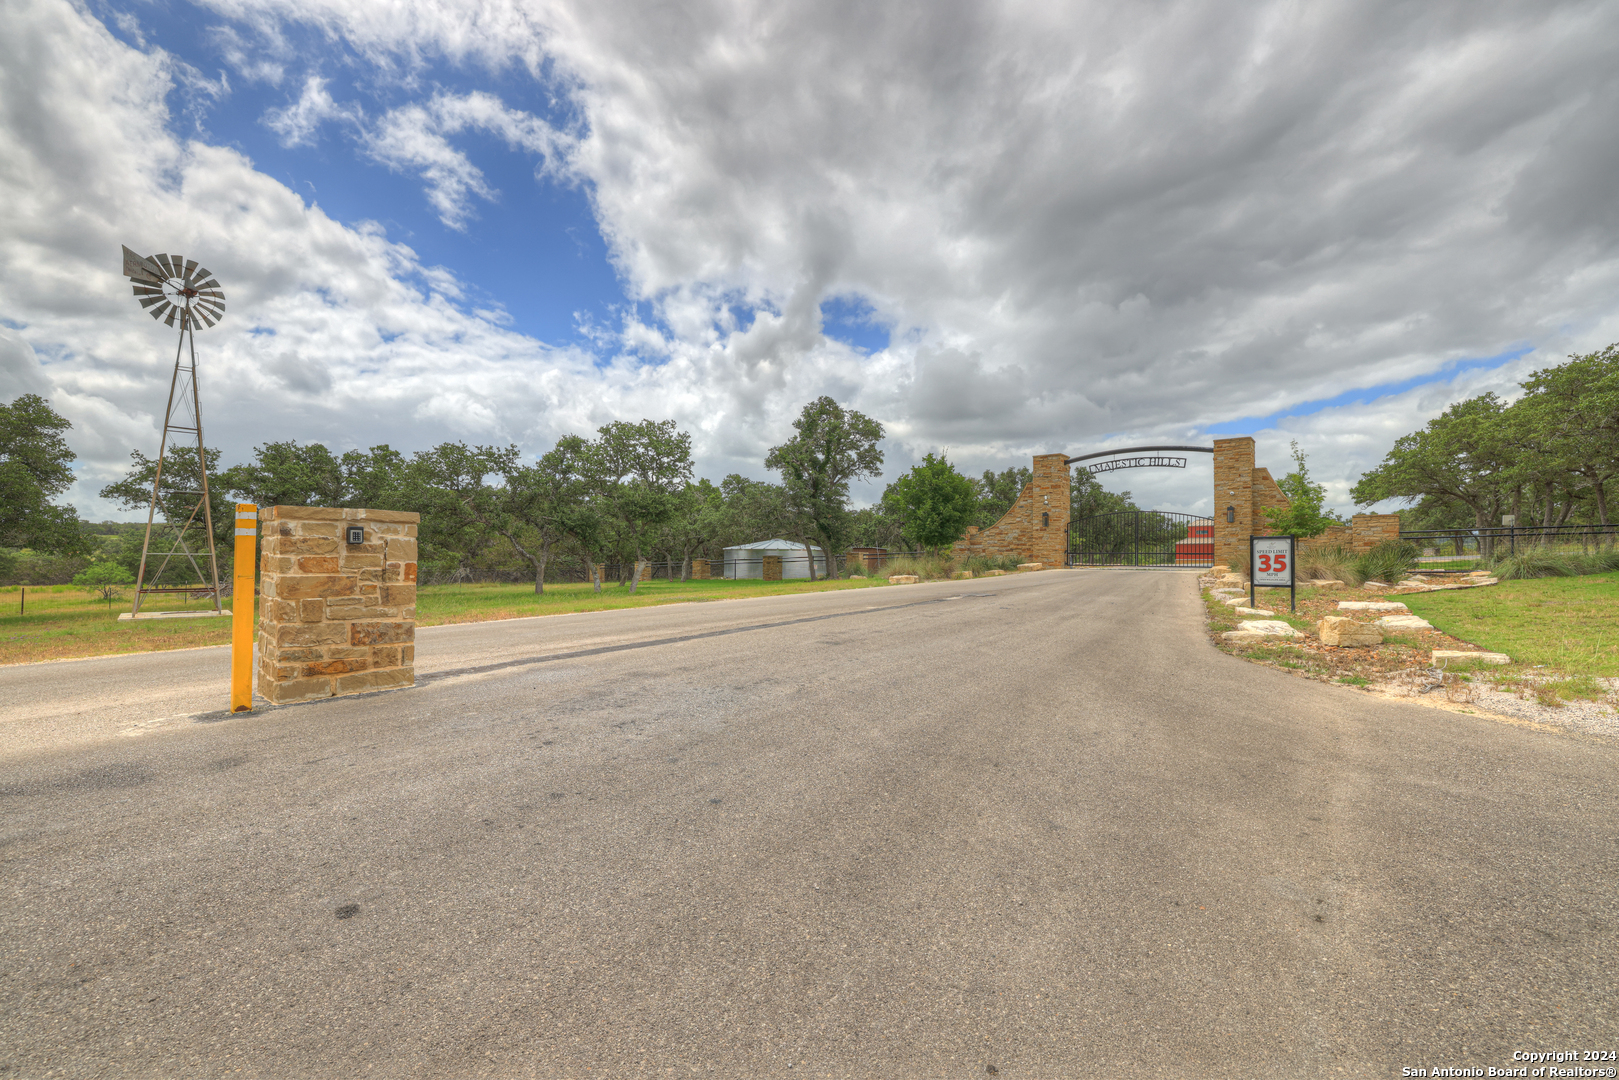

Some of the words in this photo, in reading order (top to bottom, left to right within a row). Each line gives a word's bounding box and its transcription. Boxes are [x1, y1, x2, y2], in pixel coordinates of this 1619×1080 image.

[1093, 457, 1145, 473] MAJESTIC
[1149, 457, 1181, 467] HILLS
[1258, 554, 1287, 572] 35
